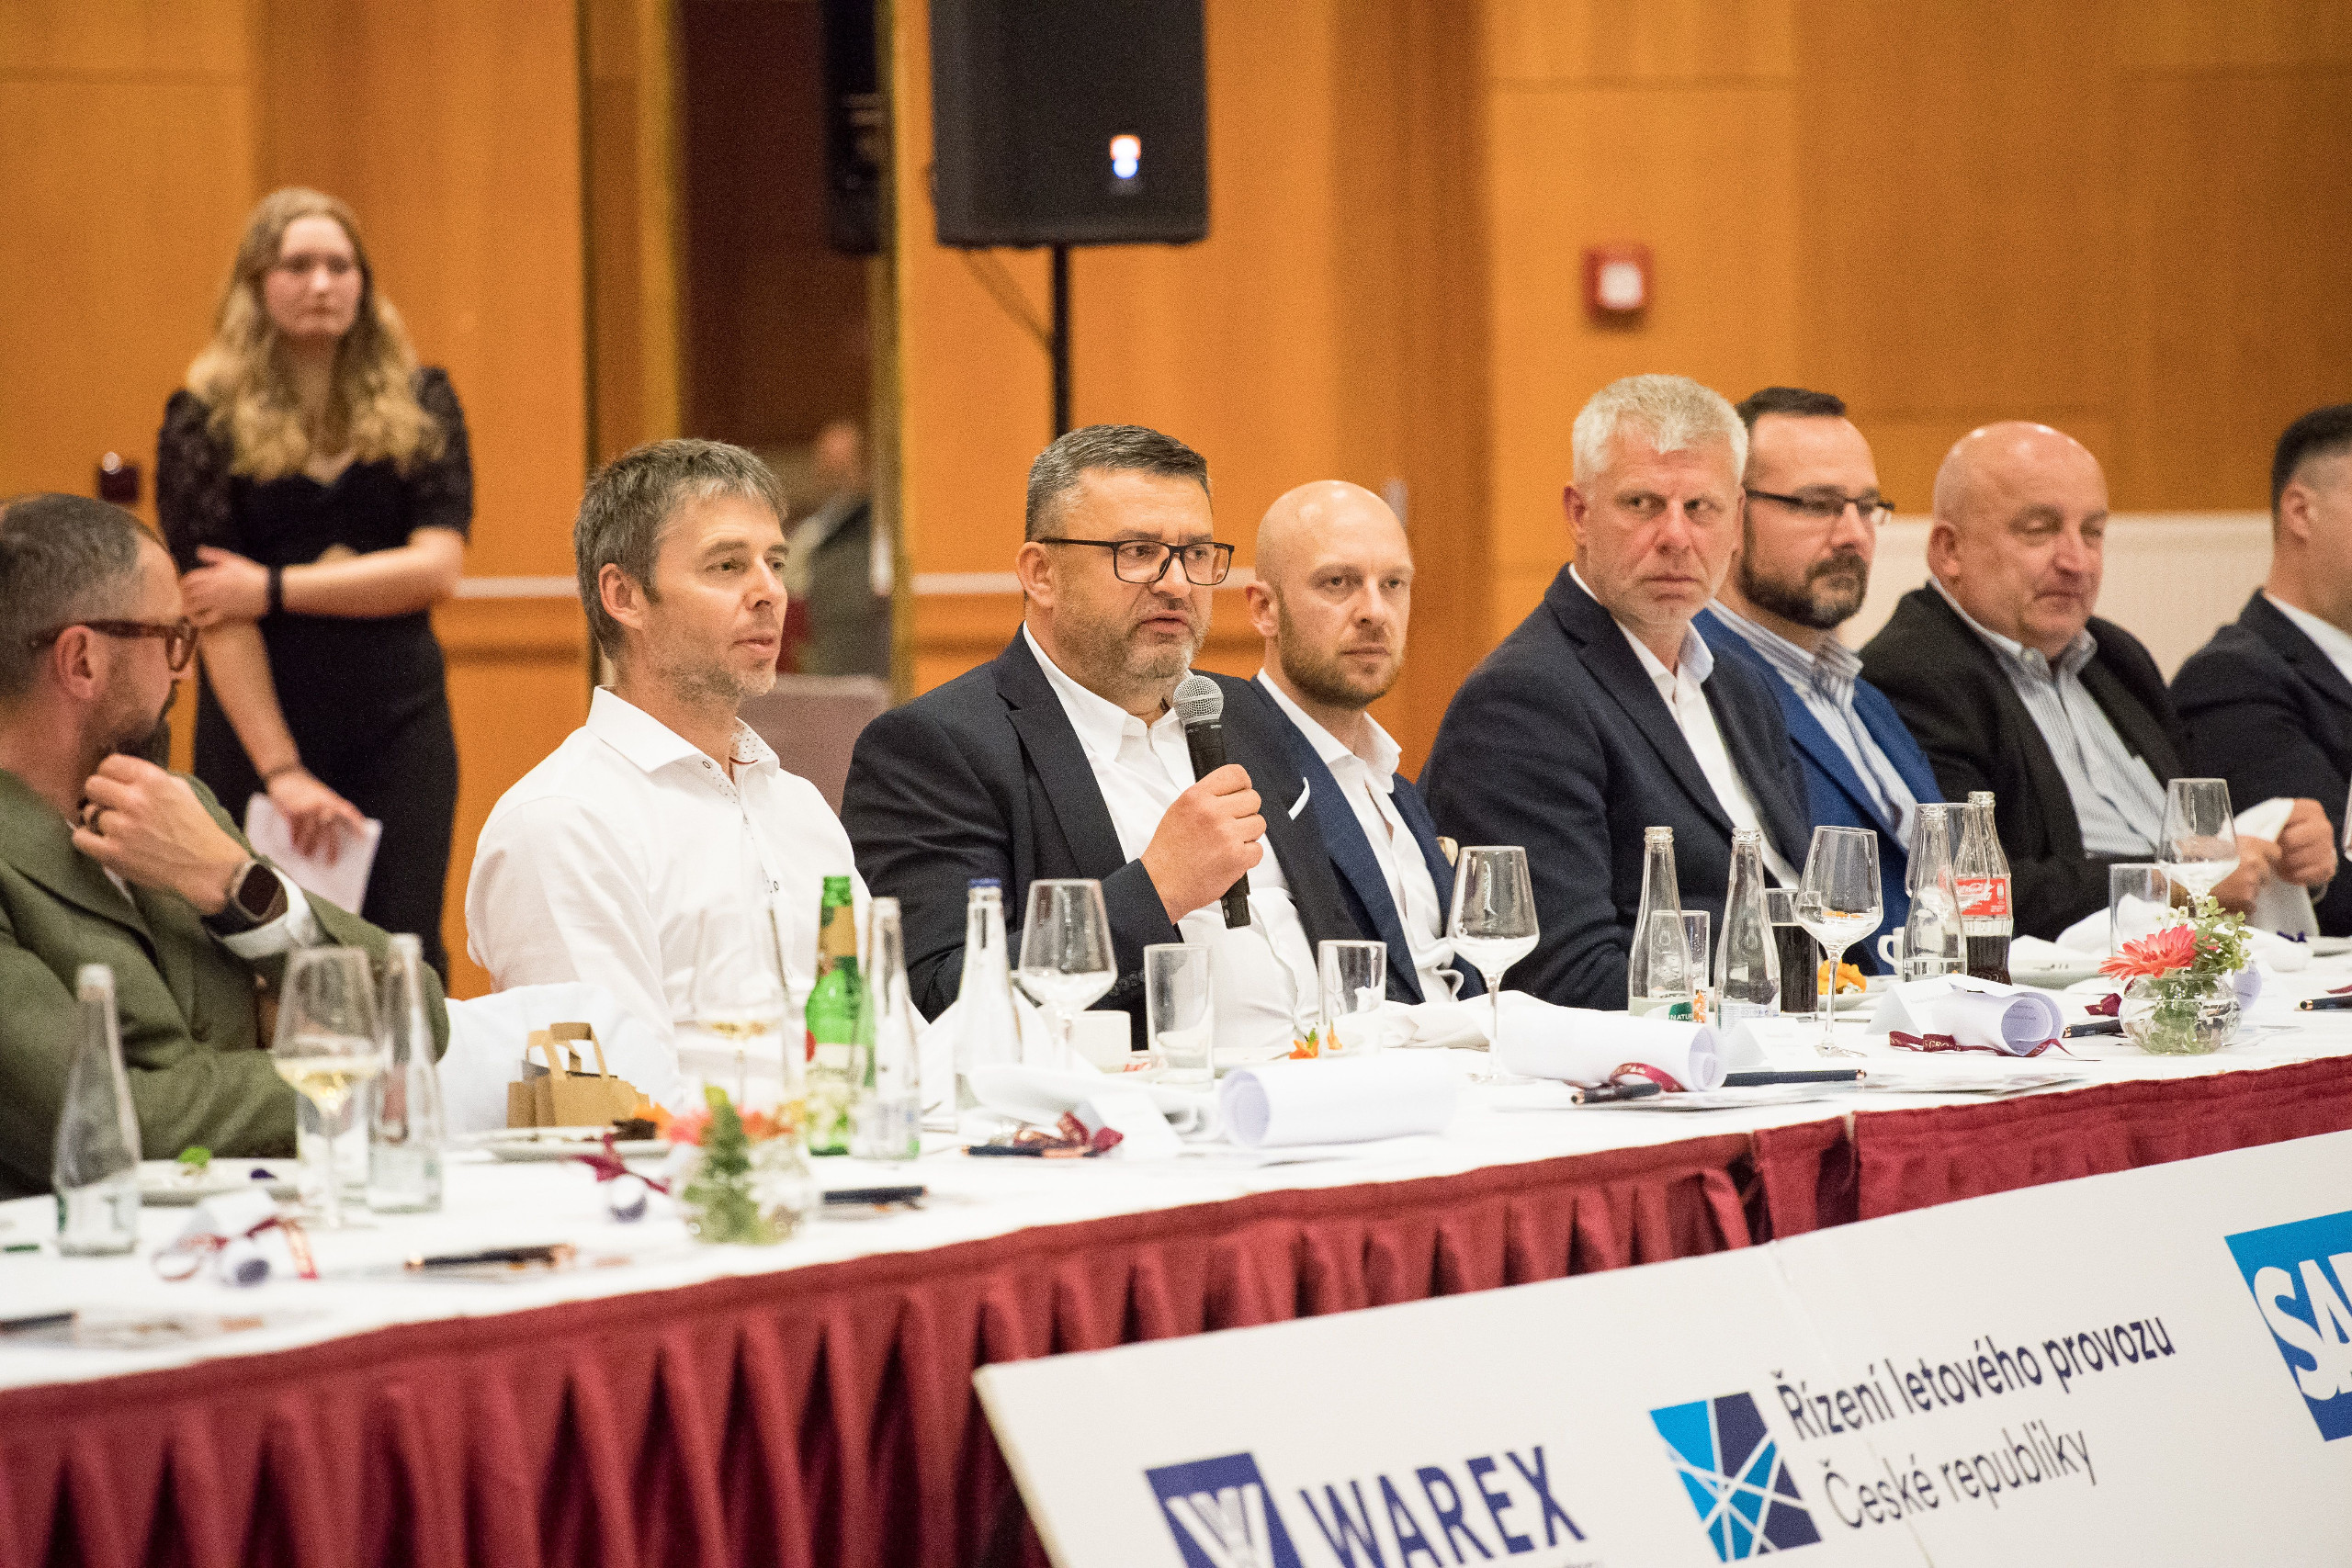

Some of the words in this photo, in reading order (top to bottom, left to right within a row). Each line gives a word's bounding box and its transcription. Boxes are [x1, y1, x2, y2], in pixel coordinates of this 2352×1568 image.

[1771, 1369, 1894, 1440] Řízení
[1884, 1335, 2042, 1415] letového
[2042, 1316, 2176, 1394] provozu
[1299, 1445, 1587, 1568] WAREX
[1819, 1458, 1939, 1529] České
[1939, 1418, 2097, 1509] republiky
